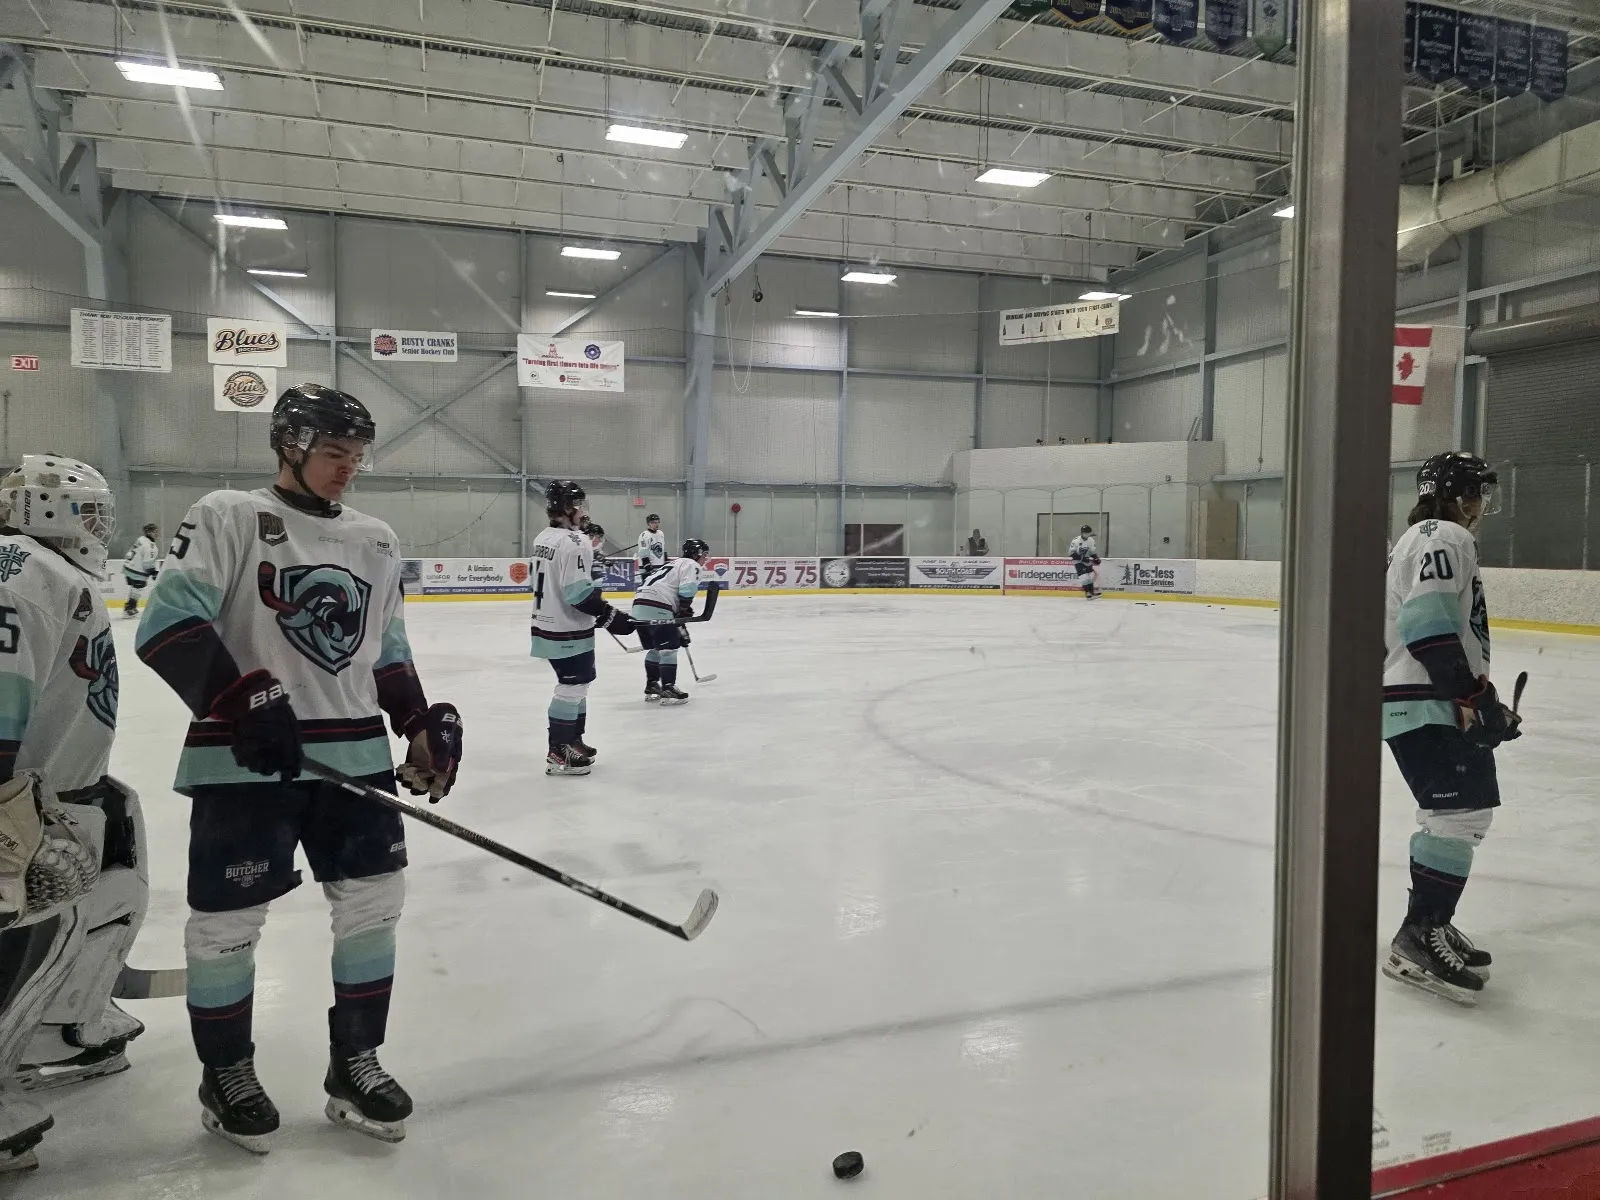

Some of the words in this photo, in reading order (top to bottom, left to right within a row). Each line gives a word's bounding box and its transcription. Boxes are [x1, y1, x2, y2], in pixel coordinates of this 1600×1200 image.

[214, 328, 279, 352] Blues
[401, 337, 425, 347] RUSTY
[427, 338, 455, 348] CRANKS
[401, 347, 420, 355] Senior
[421, 348, 441, 356] Hockey
[442, 348, 455, 356] Club
[11, 357, 39, 369] EXIT
[223, 381, 269, 397] Blues
[1419, 483, 1430, 495] 20
[22, 489, 32, 527] BAUER
[467, 564, 473, 572] A
[474, 564, 494, 572] Union
[577, 554, 586, 573] 4
[1419, 549, 1454, 583] 20
[457, 574, 467, 582] for
[468, 574, 504, 584] Everybody
[734, 566, 758, 585] 75
[763, 566, 788, 585] 75
[794, 565, 818, 584] 75
[1150, 578, 1175, 587] Services
[650, 619, 677, 627] CCM
[225, 861, 270, 879] BUTCHER
[219, 940, 252, 954] CCM
